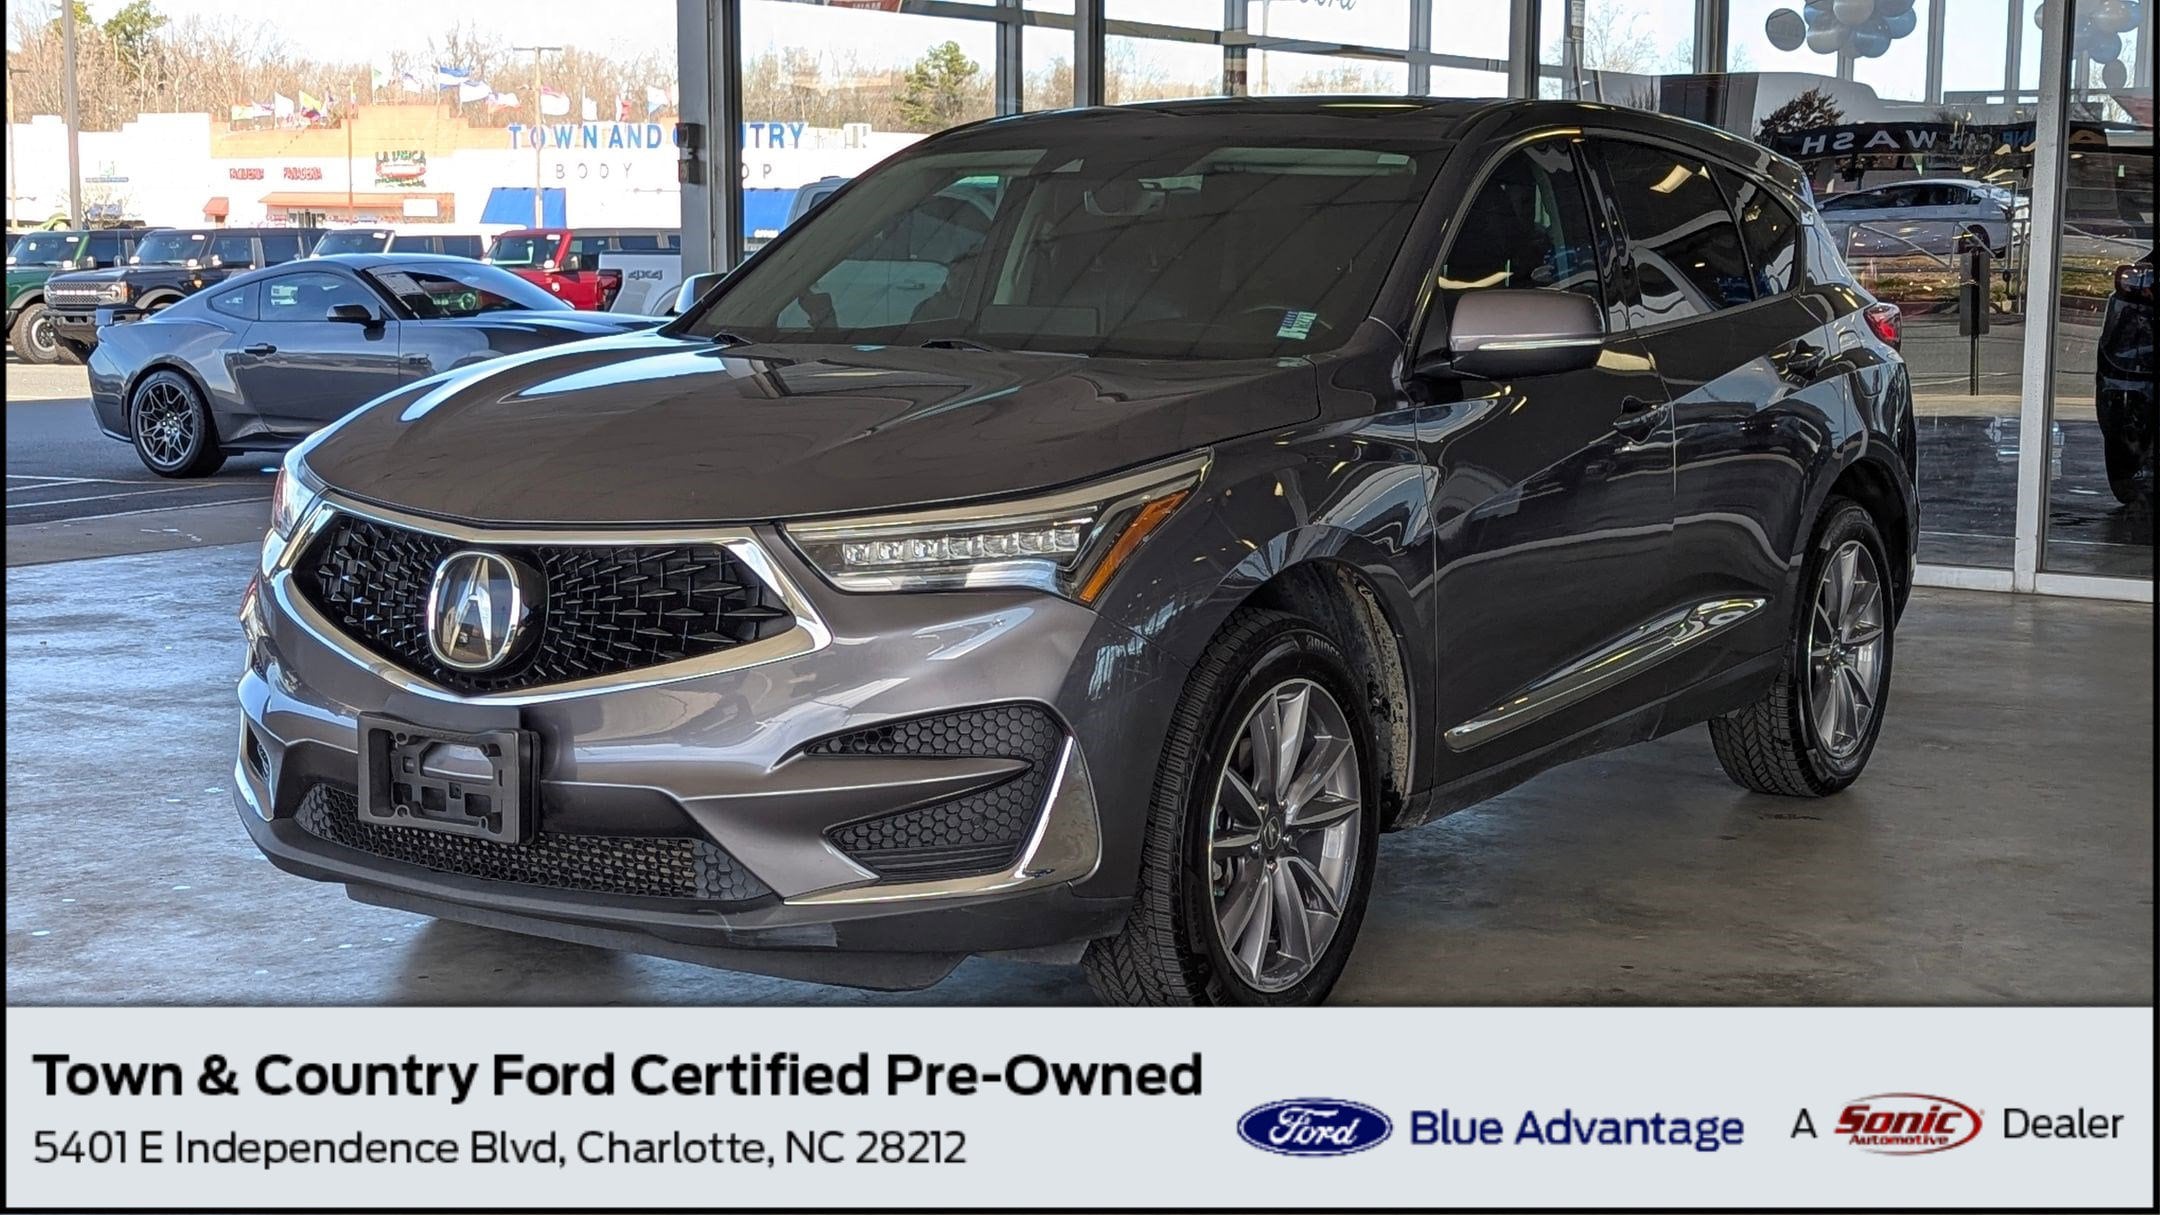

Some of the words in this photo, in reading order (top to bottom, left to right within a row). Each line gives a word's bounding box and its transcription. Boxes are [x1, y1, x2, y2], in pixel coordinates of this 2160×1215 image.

[508, 125, 598, 149] TOWN
[608, 125, 662, 149] AND
[556, 163, 633, 180] BODY
